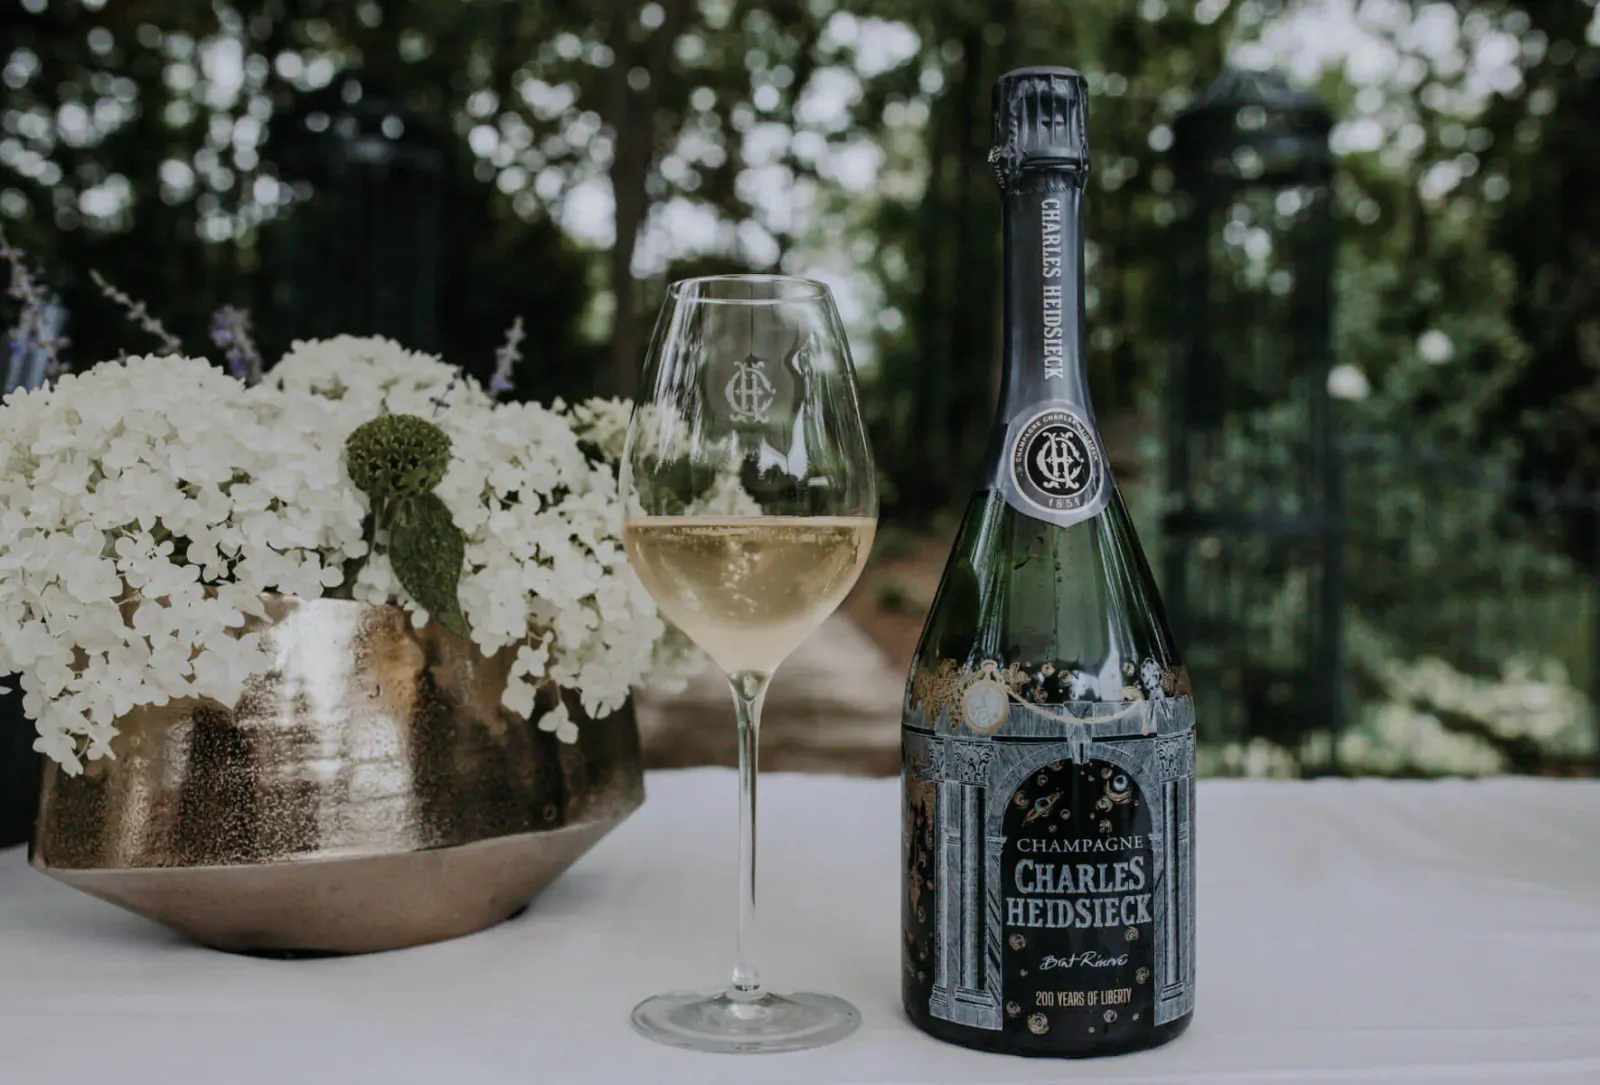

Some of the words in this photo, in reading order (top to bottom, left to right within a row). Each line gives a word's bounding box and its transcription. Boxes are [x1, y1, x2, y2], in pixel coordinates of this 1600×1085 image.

[1041, 199, 1061, 278] CHARLES
[1043, 285, 1064, 380] HEIDSIECK
[1015, 420, 1042, 462] CHAMPAGNE
[1048, 497, 1081, 509] 1851
[1016, 835, 1144, 853] CHAMPAGNE
[1014, 855, 1146, 894] CHARLES
[1006, 893, 1153, 928] HEIDSIECK
[1039, 952, 1080, 971] Brut
[1035, 990, 1055, 1006] 200
[1057, 991, 1085, 1007] YEARS
[1087, 990, 1099, 1006] OF
[1100, 987, 1132, 1006] LIBERTY
